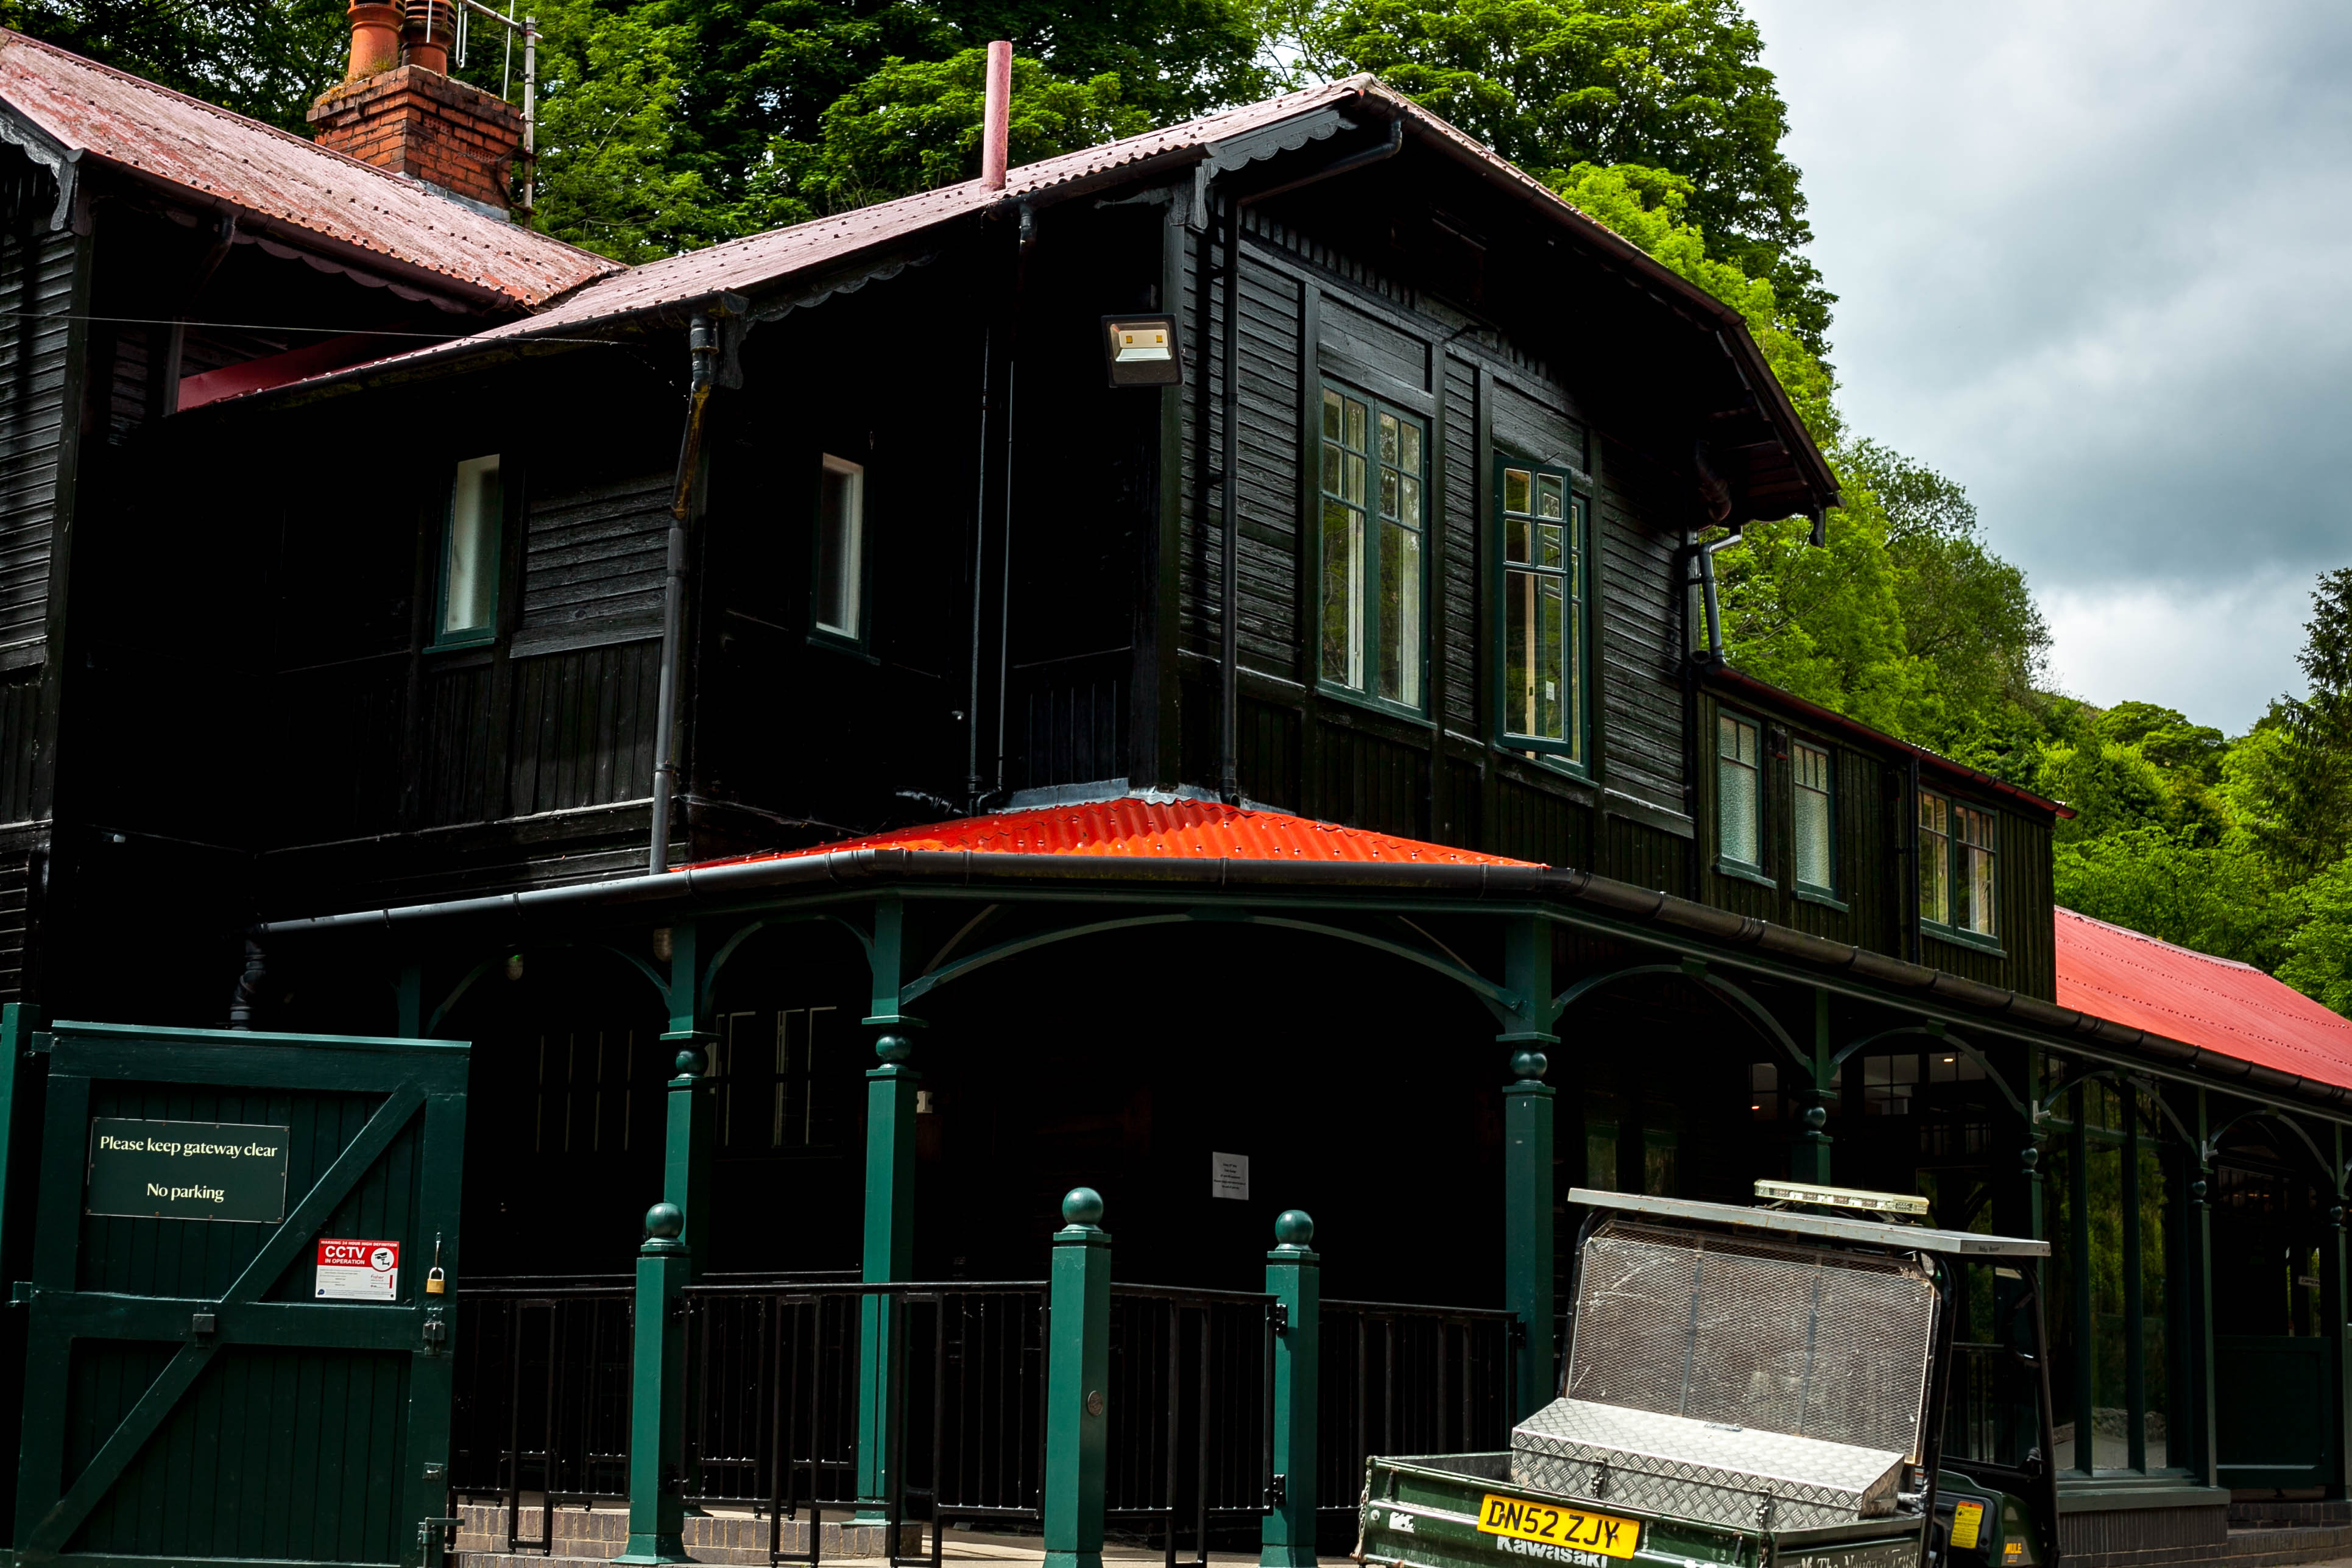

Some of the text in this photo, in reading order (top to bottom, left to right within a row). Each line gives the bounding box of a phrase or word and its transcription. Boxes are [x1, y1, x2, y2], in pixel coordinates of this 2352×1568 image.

[100, 1136, 278, 1159] Please keep gateway clear
[147, 1183, 224, 1202] No parking
[325, 1246, 366, 1259] CCTV
[1486, 1500, 1620, 1549] DN52 ZJY
[1497, 1536, 1608, 1568] Kawasaki
